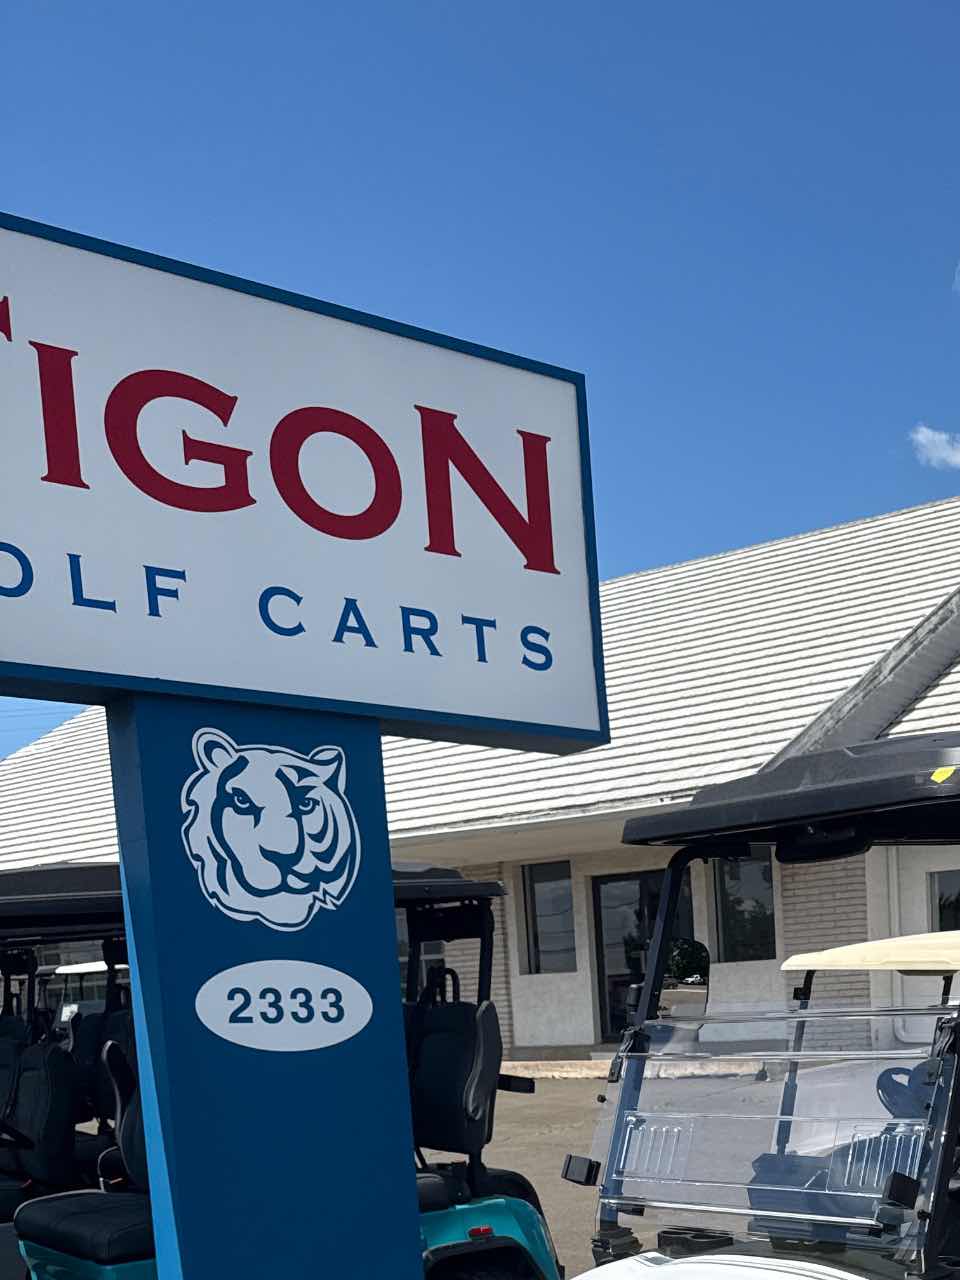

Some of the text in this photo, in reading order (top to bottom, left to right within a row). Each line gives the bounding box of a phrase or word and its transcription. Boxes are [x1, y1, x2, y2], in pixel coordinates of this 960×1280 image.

[0, 296, 560, 575] IGON
[258, 586, 554, 672] CARTS
[227, 987, 345, 1024] 2333
